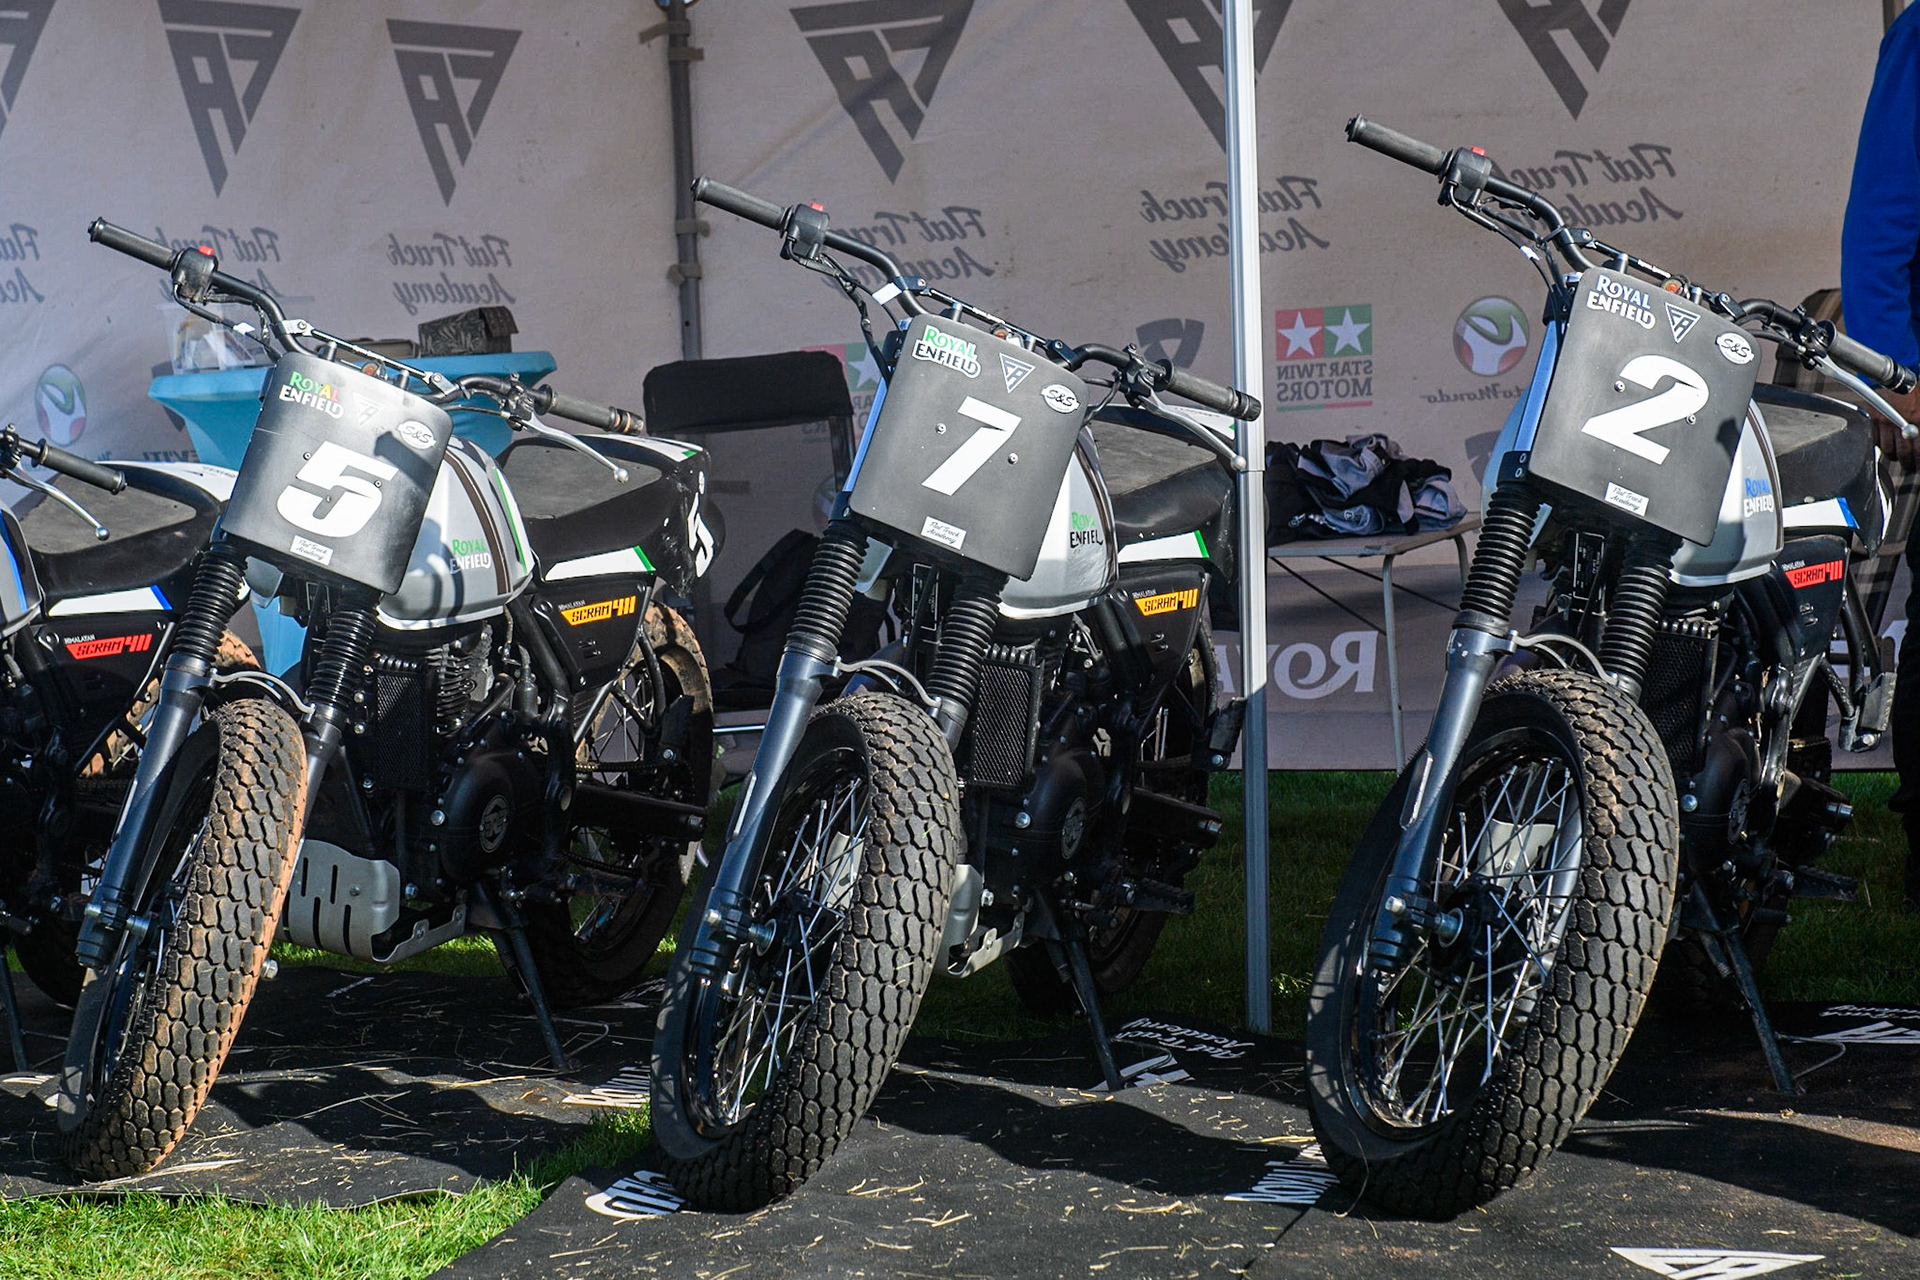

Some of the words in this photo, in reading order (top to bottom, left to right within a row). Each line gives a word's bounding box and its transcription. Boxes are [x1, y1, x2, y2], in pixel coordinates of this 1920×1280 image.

[1596, 274, 1651, 310] ROYAL
[1586, 291, 1656, 329] ENFIELD
[914, 342, 979, 376] ENFIELD
[925, 327, 976, 358] ROYAL
[279, 384, 345, 420] ENFIELD
[289, 371, 341, 402] ROYAL
[1580, 354, 1709, 465] 2
[921, 395, 1022, 497] 7
[277, 440, 399, 538] 5
[1744, 477, 1771, 498] ROYAL
[1743, 495, 1775, 518] ENFIELD
[450, 552, 491, 574] ENFIELD
[452, 539, 487, 556] ROYAL
